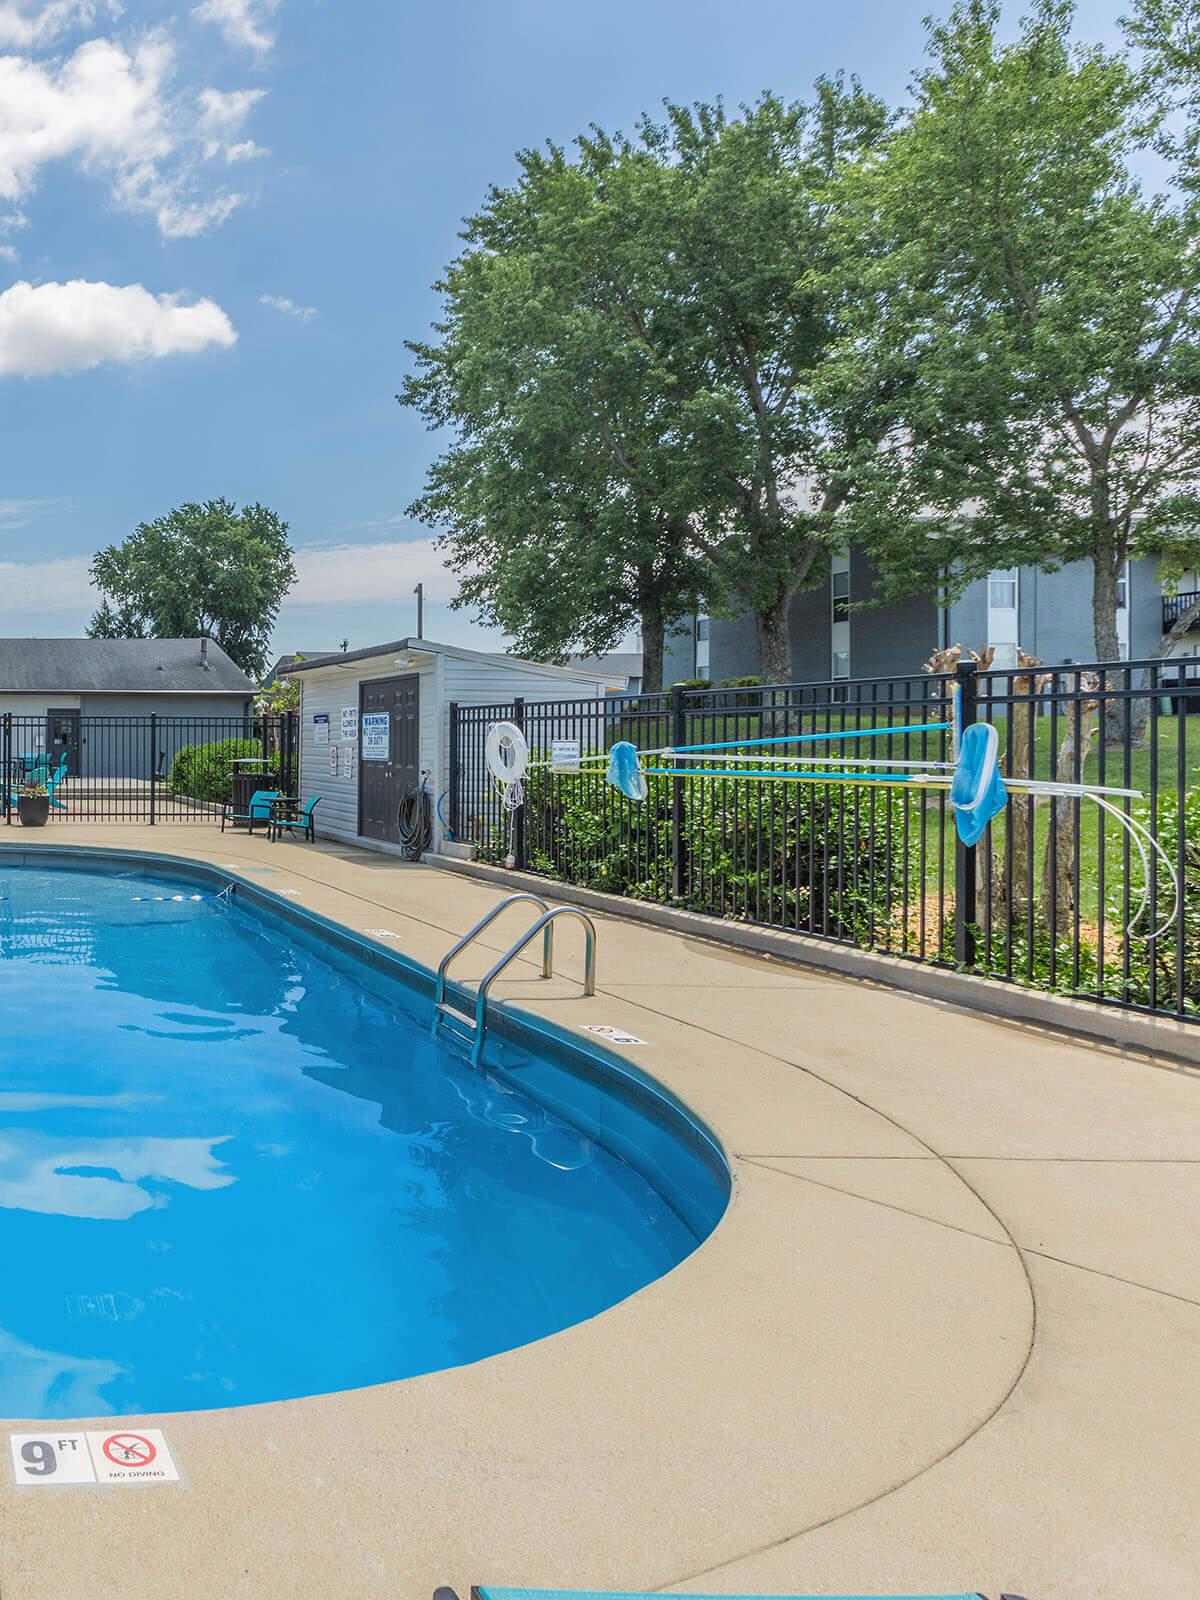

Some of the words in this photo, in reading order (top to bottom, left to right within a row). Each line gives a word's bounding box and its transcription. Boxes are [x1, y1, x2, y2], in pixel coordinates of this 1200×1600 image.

[364, 716, 388, 726] WARNING
[368, 727, 388, 736] LIFEGUARD
[367, 737, 373, 745] ON
[373, 736, 383, 745] DUTY
[20, 1440, 57, 1476] 9
[57, 1439, 78, 1451] FT
[128, 1470, 165, 1478] DIVING
